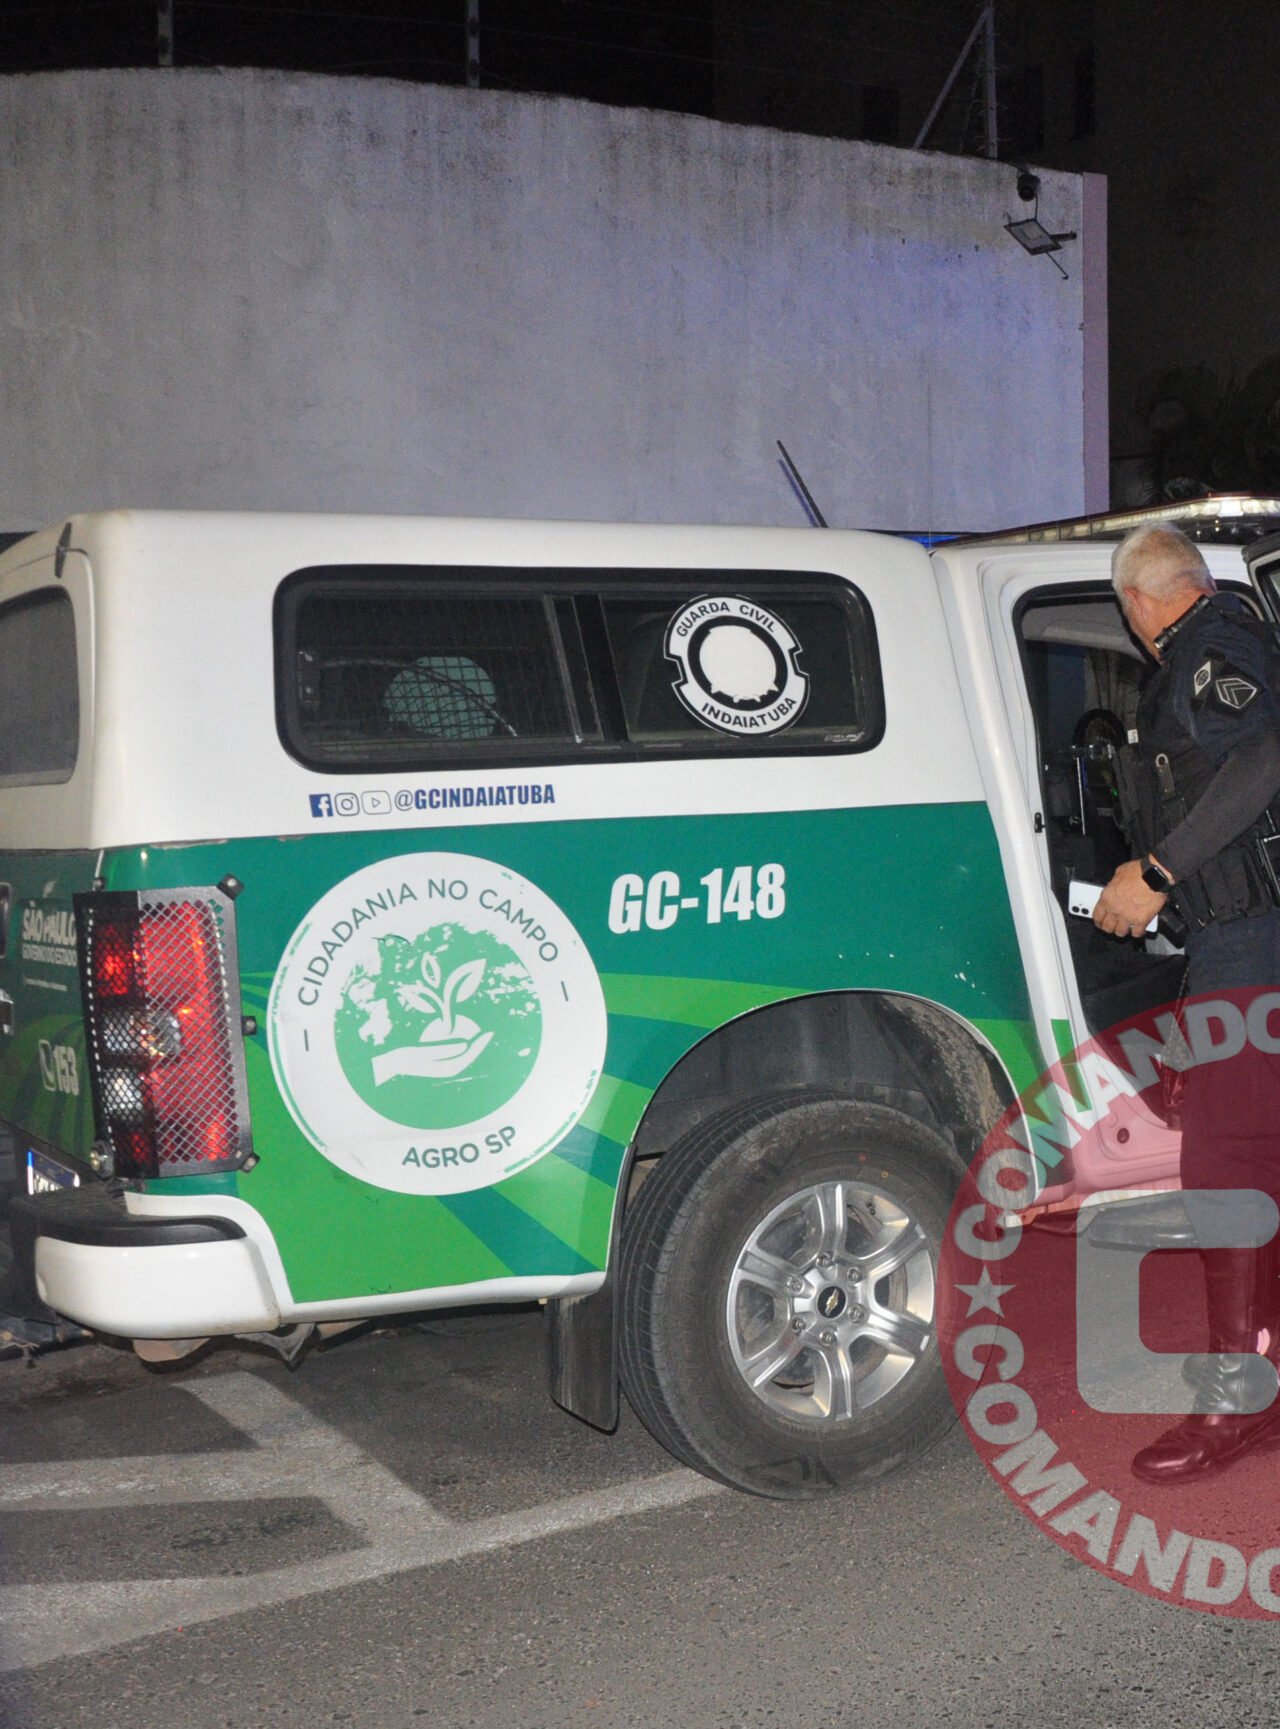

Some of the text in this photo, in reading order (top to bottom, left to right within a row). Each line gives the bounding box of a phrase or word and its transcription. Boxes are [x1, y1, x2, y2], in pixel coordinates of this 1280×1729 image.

[676, 601, 776, 638] GUARDA CIVIL
[701, 697, 796, 728] INDAIATUBA
[394, 784, 555, 812] @GCINDAIATUBA
[607, 862, 786, 935] GC-148
[298, 877, 560, 1008] CIDADANIA NO CAMPO
[52, 1044, 80, 1097] 153
[401, 1126, 517, 1168] AGRO SP
